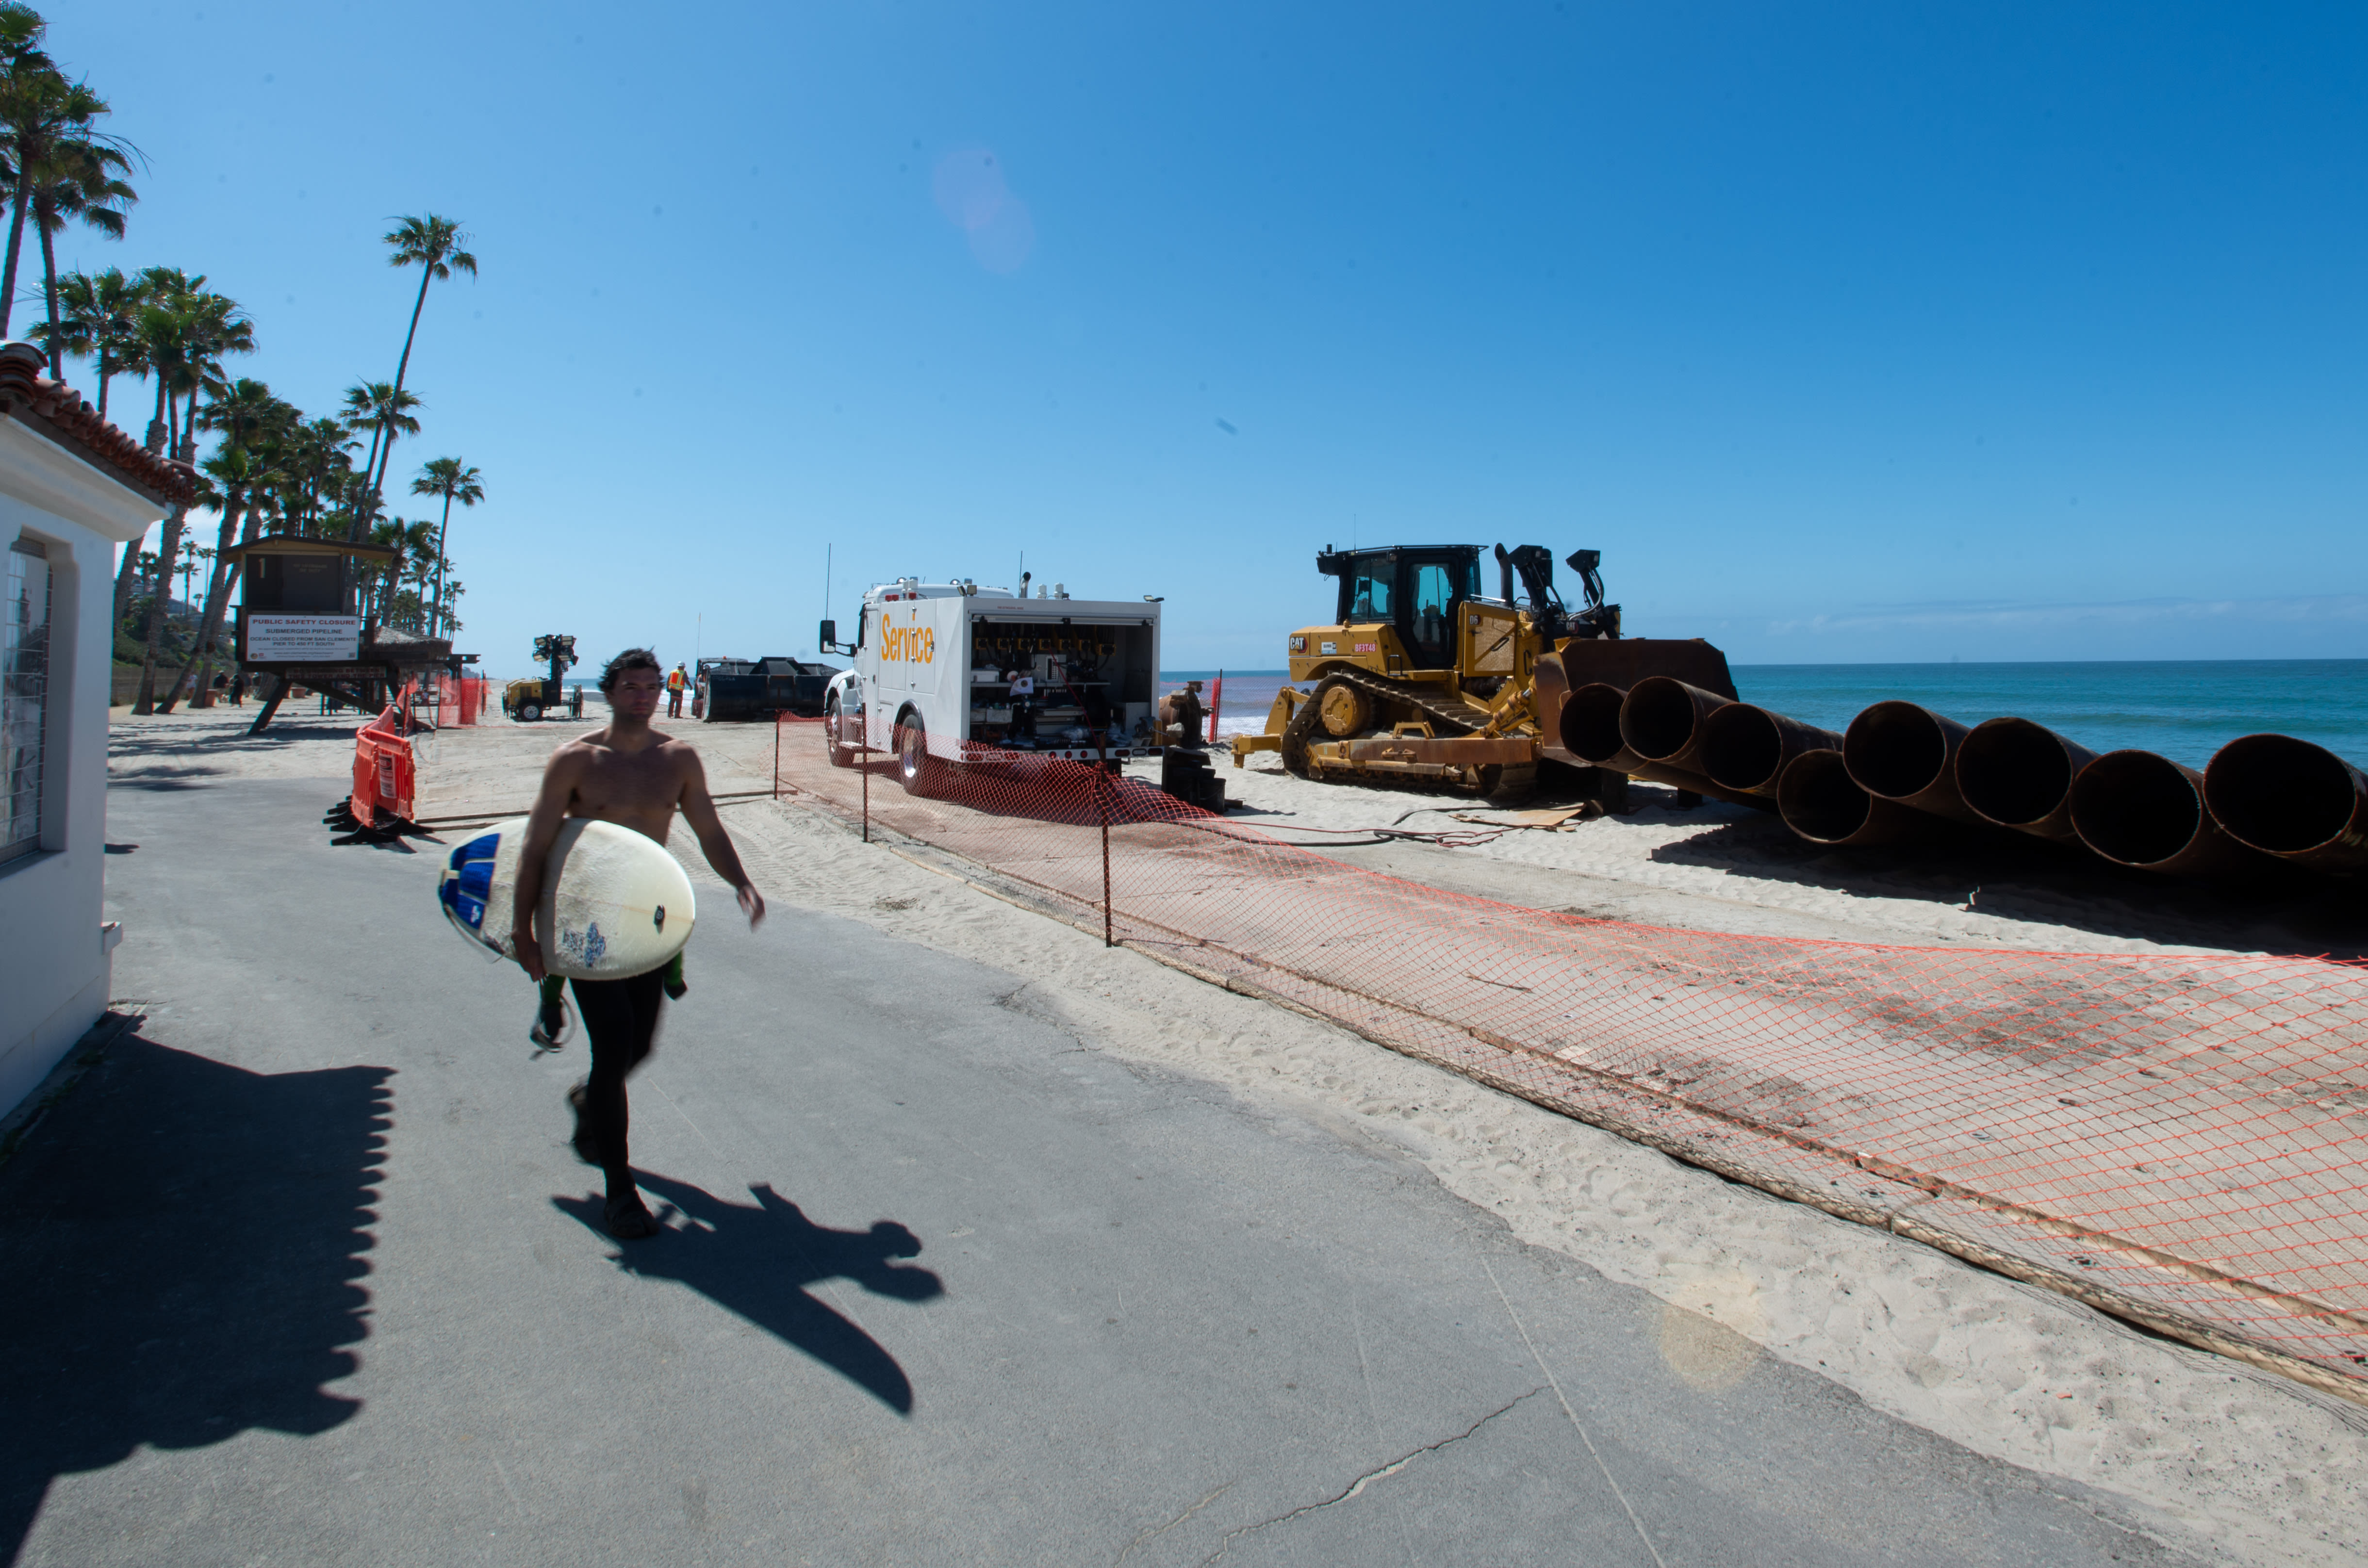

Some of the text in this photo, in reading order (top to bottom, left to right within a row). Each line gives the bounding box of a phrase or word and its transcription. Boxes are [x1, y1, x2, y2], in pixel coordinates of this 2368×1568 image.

[259, 558, 266, 578] 1
[1469, 615, 1478, 624] D6
[1566, 621, 1575, 631] CAT
[881, 613, 933, 664] Service
[1290, 637, 1304, 650] CAT
[1355, 643, 1376, 652] BF3T48
